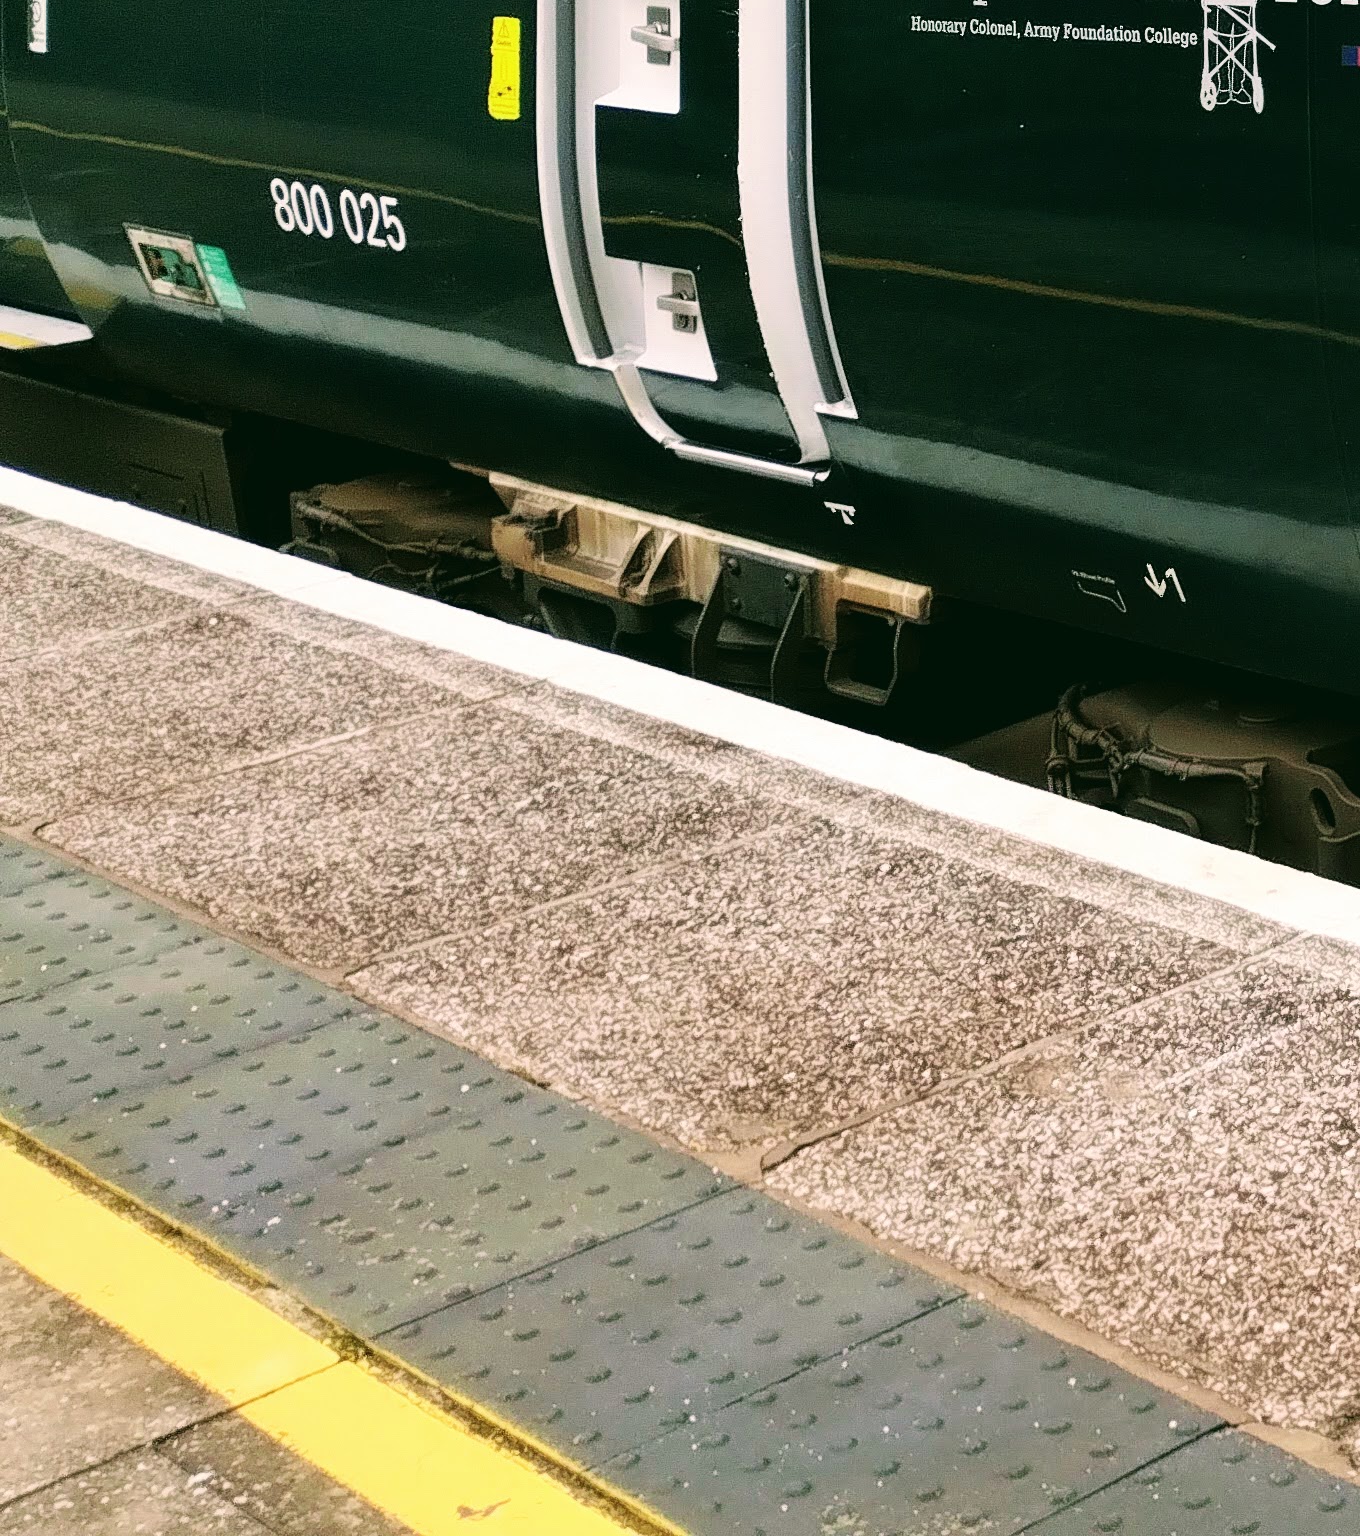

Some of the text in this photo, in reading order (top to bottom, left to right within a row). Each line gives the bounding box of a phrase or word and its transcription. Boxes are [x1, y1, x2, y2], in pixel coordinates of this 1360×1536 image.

[910, 15, 1199, 49] Honorary Colonel, Army Foundation College
[269, 177, 407, 252] 800 025
